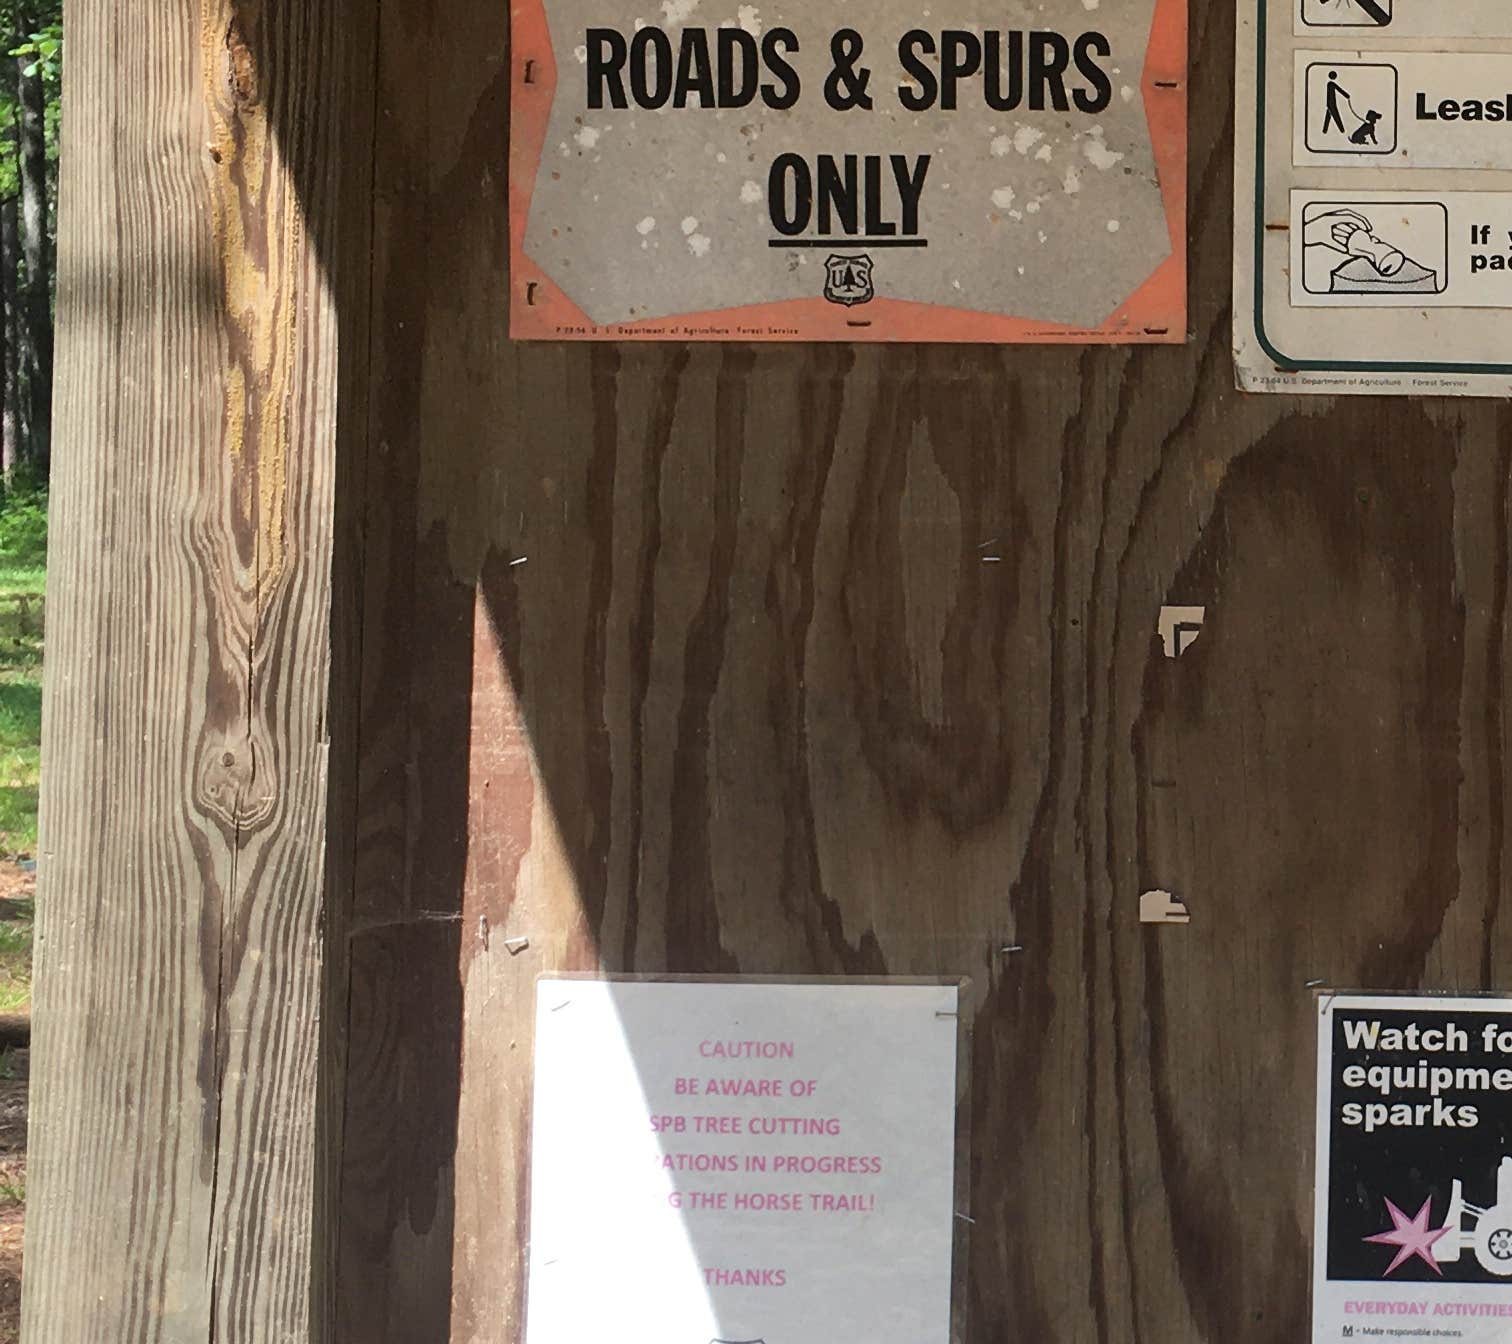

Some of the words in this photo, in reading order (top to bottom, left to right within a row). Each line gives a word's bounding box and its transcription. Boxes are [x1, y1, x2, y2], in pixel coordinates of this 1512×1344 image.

[586, 26, 800, 110] ROADS
[824, 28, 873, 111] &
[898, 29, 1112, 114] SPURS
[768, 153, 931, 235] ONLY
[1471, 225, 1490, 244] If
[1343, 1021, 1468, 1052] Watch
[699, 1041, 795, 1058] CAUTION
[675, 1078, 699, 1095] BE
[705, 1079, 782, 1096] AWARE
[790, 1080, 818, 1097] OF
[1341, 1097, 1479, 1132] sparks
[650, 1116, 686, 1133] SPB
[693, 1116, 742, 1134] TREE
[749, 1117, 840, 1136] CUTTING
[660, 1153, 738, 1172] ATIONS
[745, 1155, 766, 1172] IN
[773, 1156, 882, 1174] PROGRESS
[689, 1192, 727, 1210] THE
[734, 1193, 803, 1210] HORSE
[810, 1194, 875, 1211] TRAIL!
[704, 1268, 786, 1287] THANKS
[1344, 1301, 1429, 1315] EVERYDAY
[1363, 1327, 1385, 1336] Make
[1387, 1327, 1431, 1338] responsible
[1432, 1328, 1463, 1337] choices.
